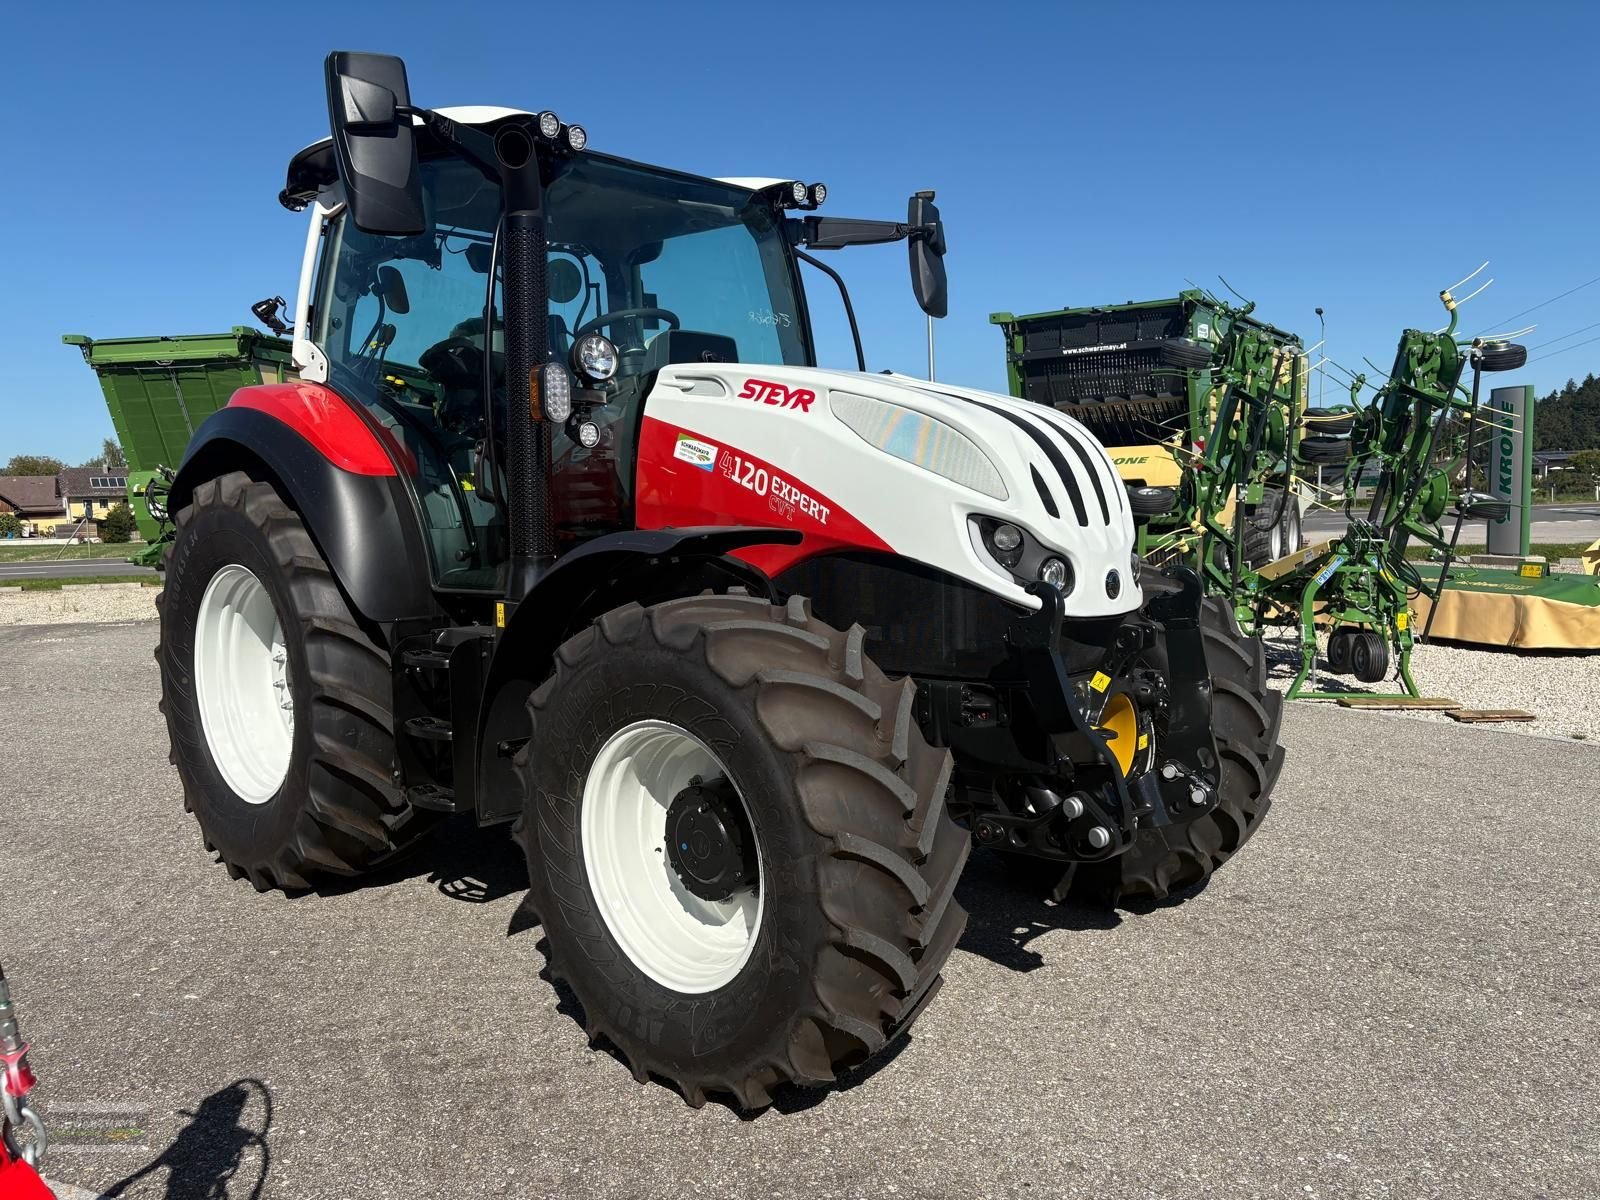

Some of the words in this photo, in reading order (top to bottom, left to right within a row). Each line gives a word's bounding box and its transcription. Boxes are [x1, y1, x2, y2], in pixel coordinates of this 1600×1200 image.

[737, 378, 816, 413] STEYR
[680, 440, 710, 456] SCHWARZMAYR
[1112, 456, 1150, 465] ONE
[1498, 400, 1514, 495] KRONE
[719, 450, 768, 497] 4120
[771, 475, 830, 525] EXPERT
[768, 495, 796, 522] CVT
